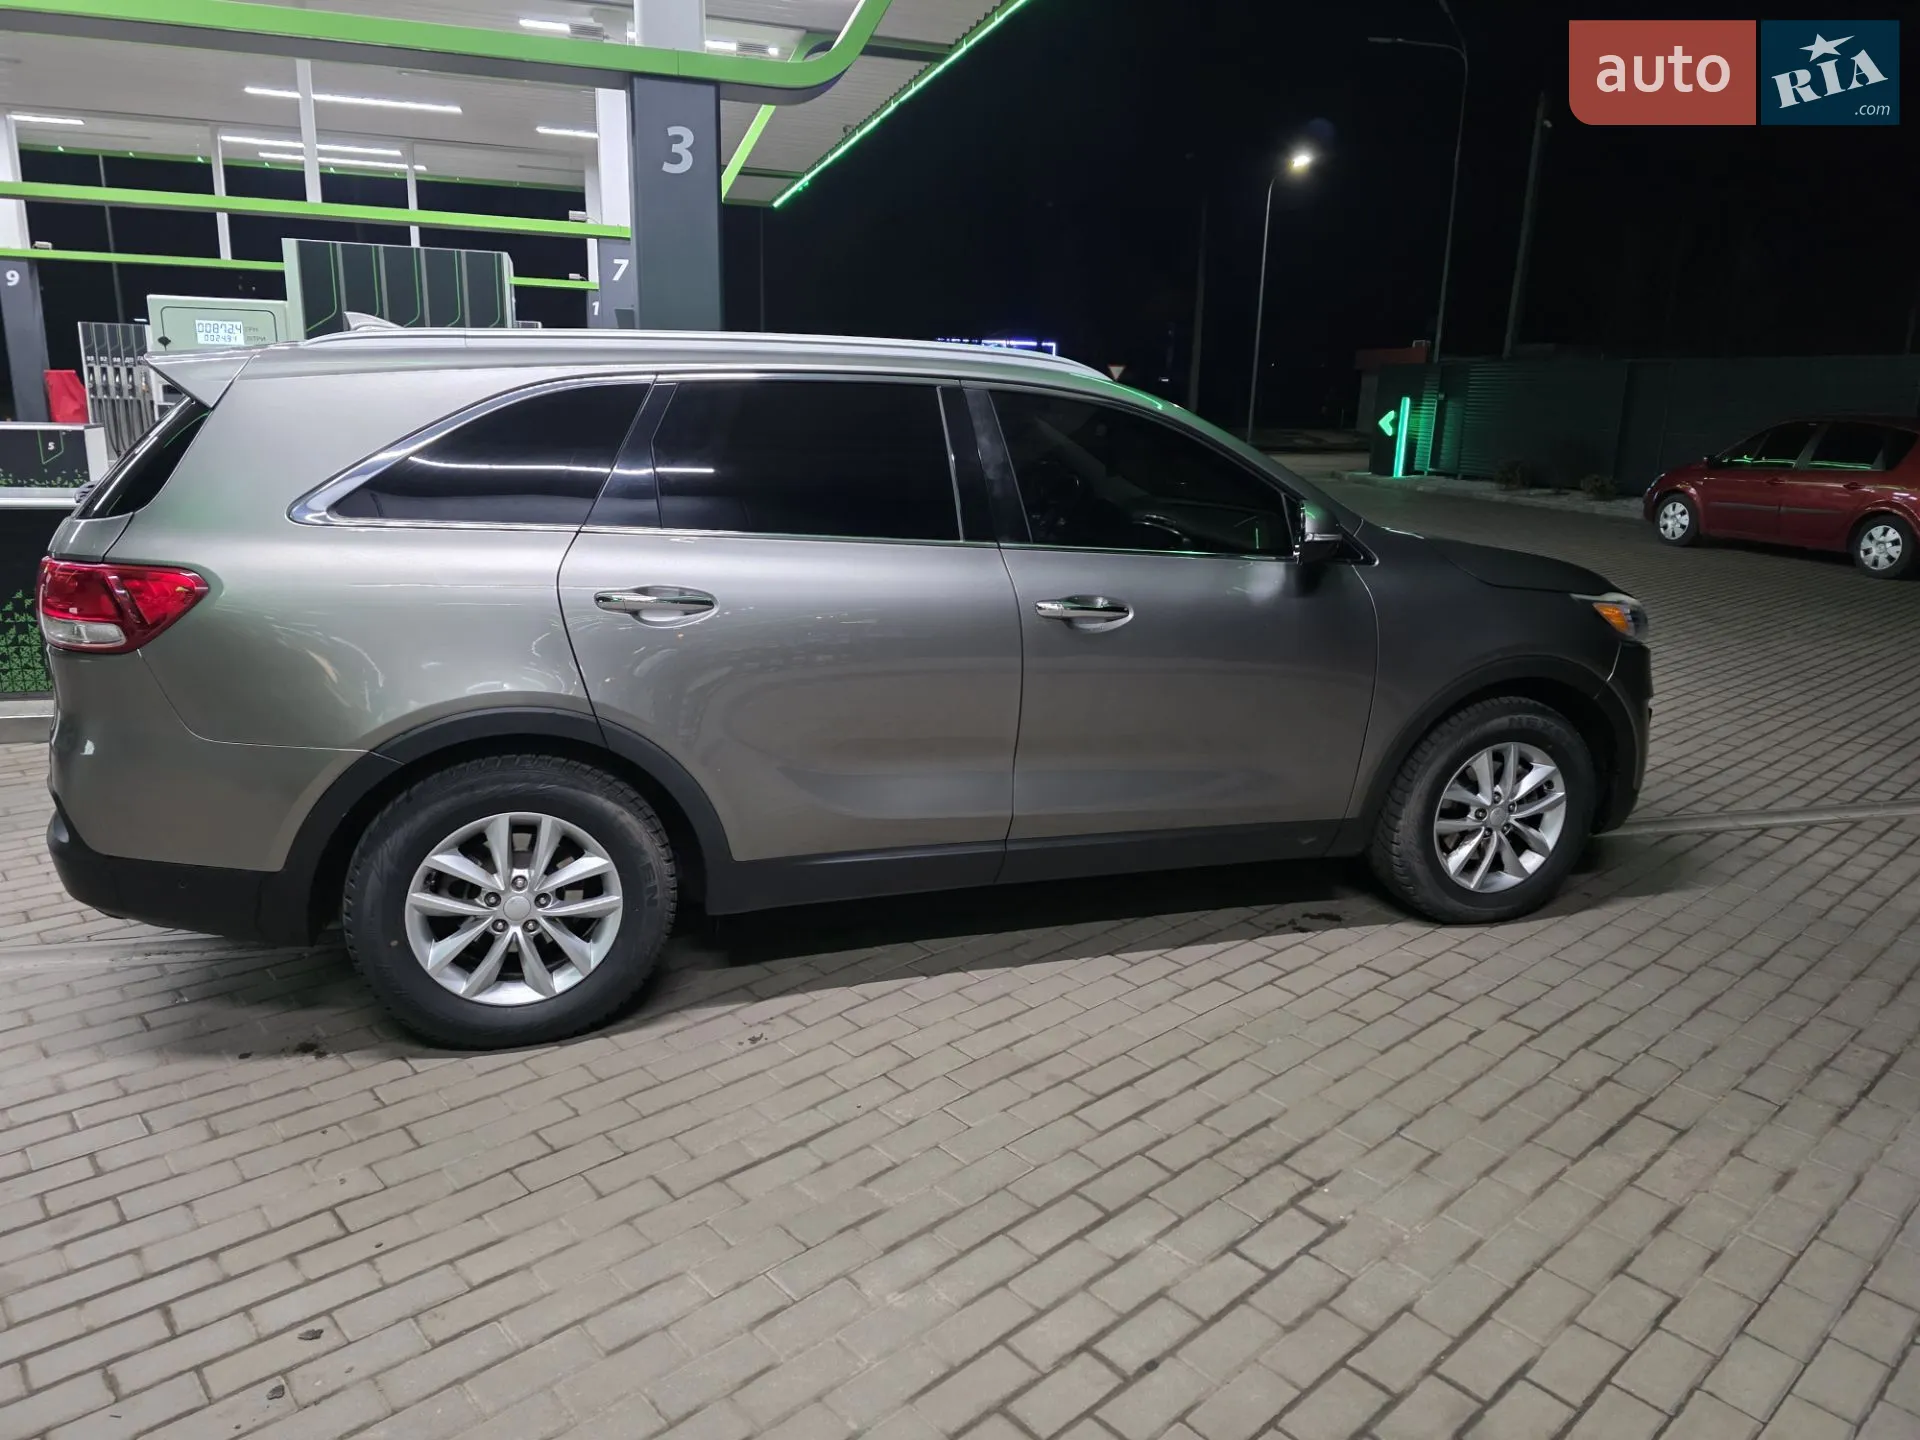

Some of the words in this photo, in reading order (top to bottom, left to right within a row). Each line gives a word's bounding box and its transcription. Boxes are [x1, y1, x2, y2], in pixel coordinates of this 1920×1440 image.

[662, 125, 695, 175] 3
[6, 269, 20, 286] 9
[612, 258, 630, 281] 7
[591, 301, 600, 316] 1
[47, 441, 56, 451] 5
